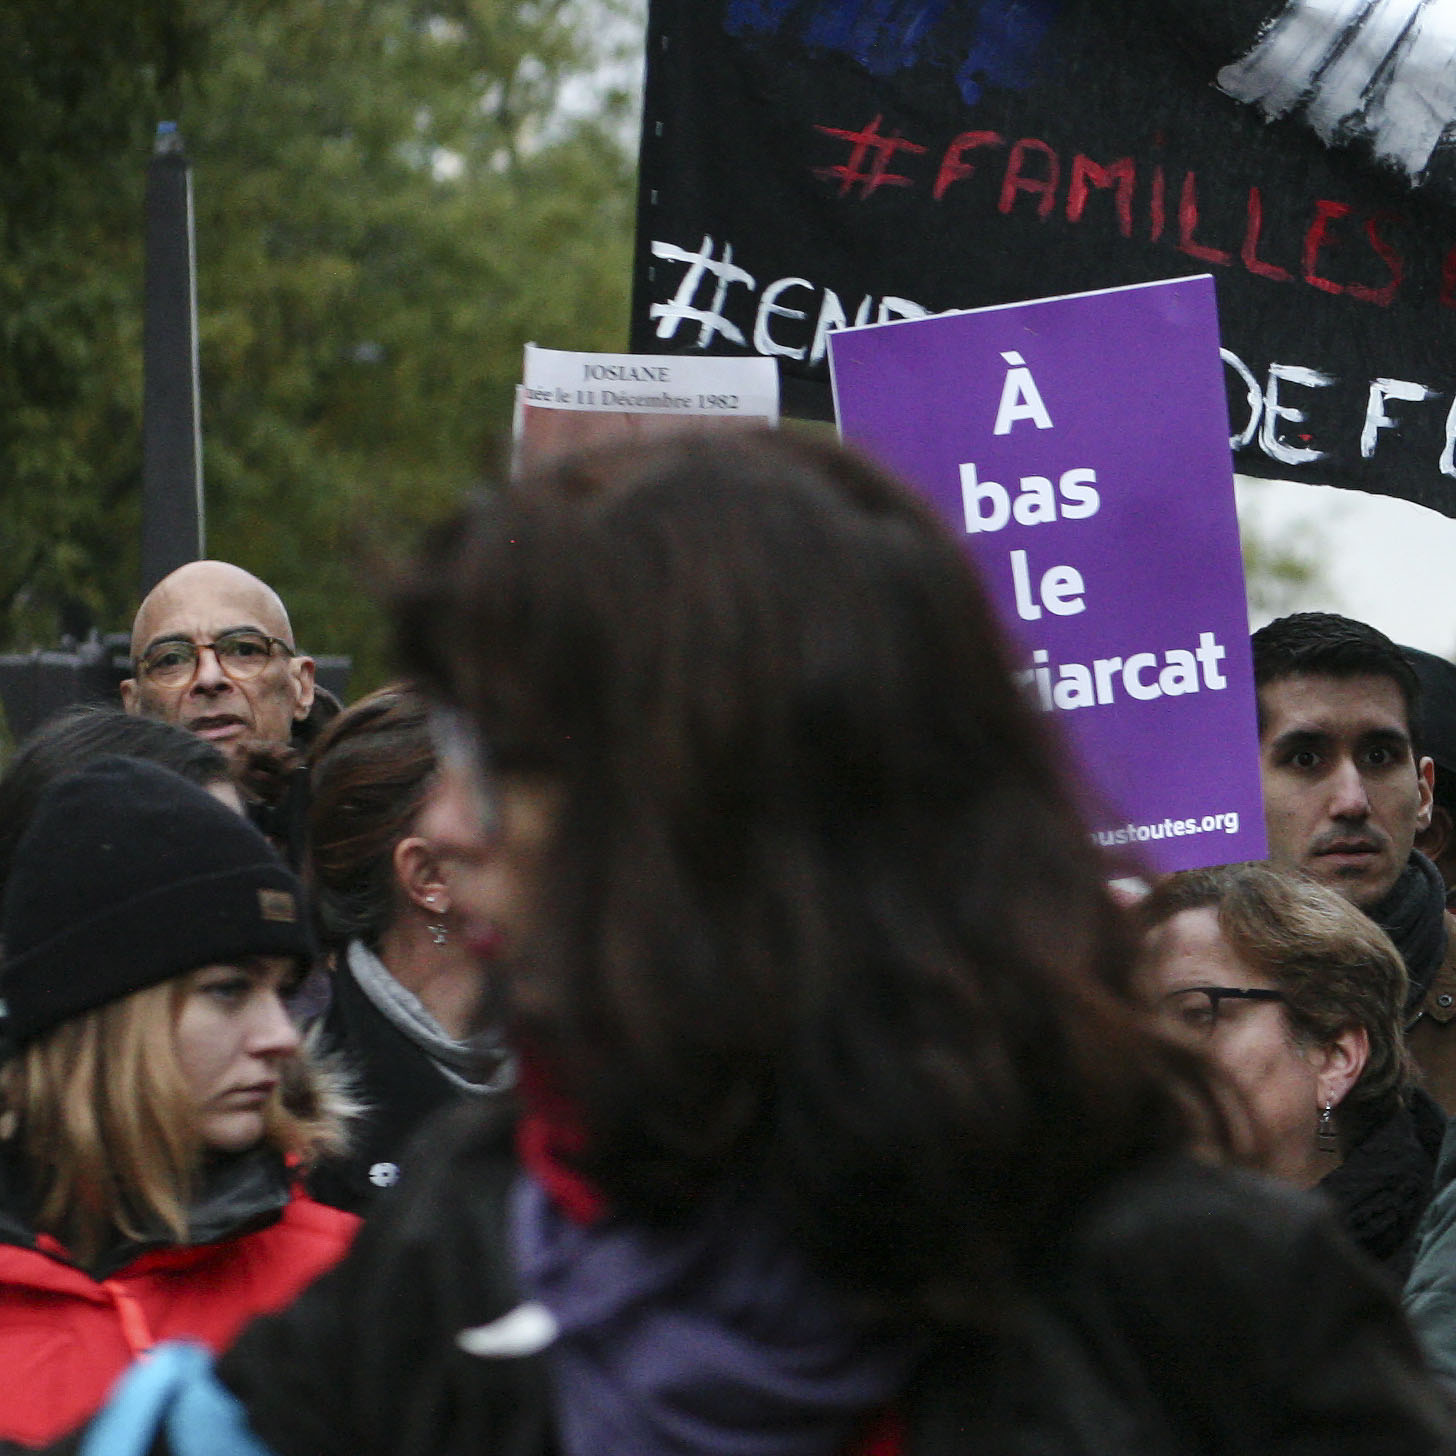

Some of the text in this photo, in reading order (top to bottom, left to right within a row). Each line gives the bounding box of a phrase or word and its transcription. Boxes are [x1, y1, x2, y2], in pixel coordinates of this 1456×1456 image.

[583, 363, 671, 383] JOSIANE
[602, 389, 692, 408] Décembre
[696, 392, 741, 410] 1982
[993, 350, 1054, 436] À
[958, 462, 1100, 534] bas
[1009, 549, 1087, 621] le
